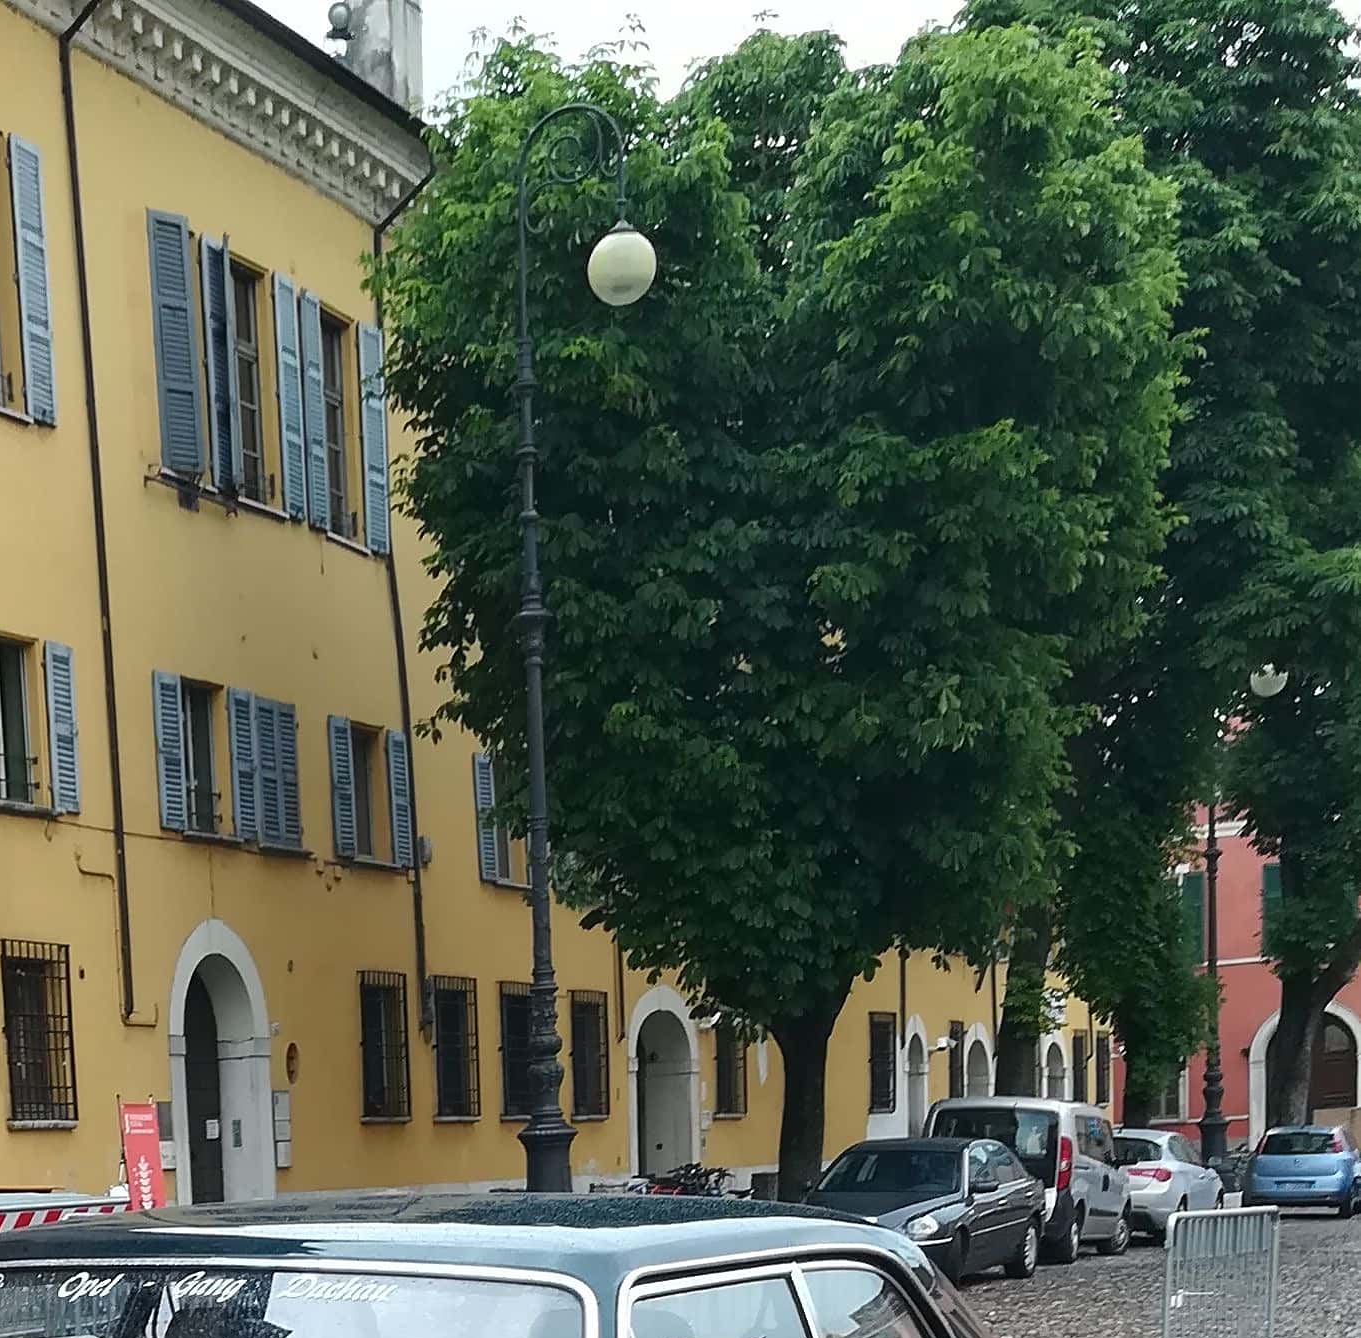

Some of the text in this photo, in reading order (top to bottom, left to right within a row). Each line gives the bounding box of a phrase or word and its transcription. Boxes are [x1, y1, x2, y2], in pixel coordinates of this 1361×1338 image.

[57, 1271, 126, 1303] Opel
[174, 1270, 248, 1303] Gang
[277, 1275, 399, 1302] Dachau
